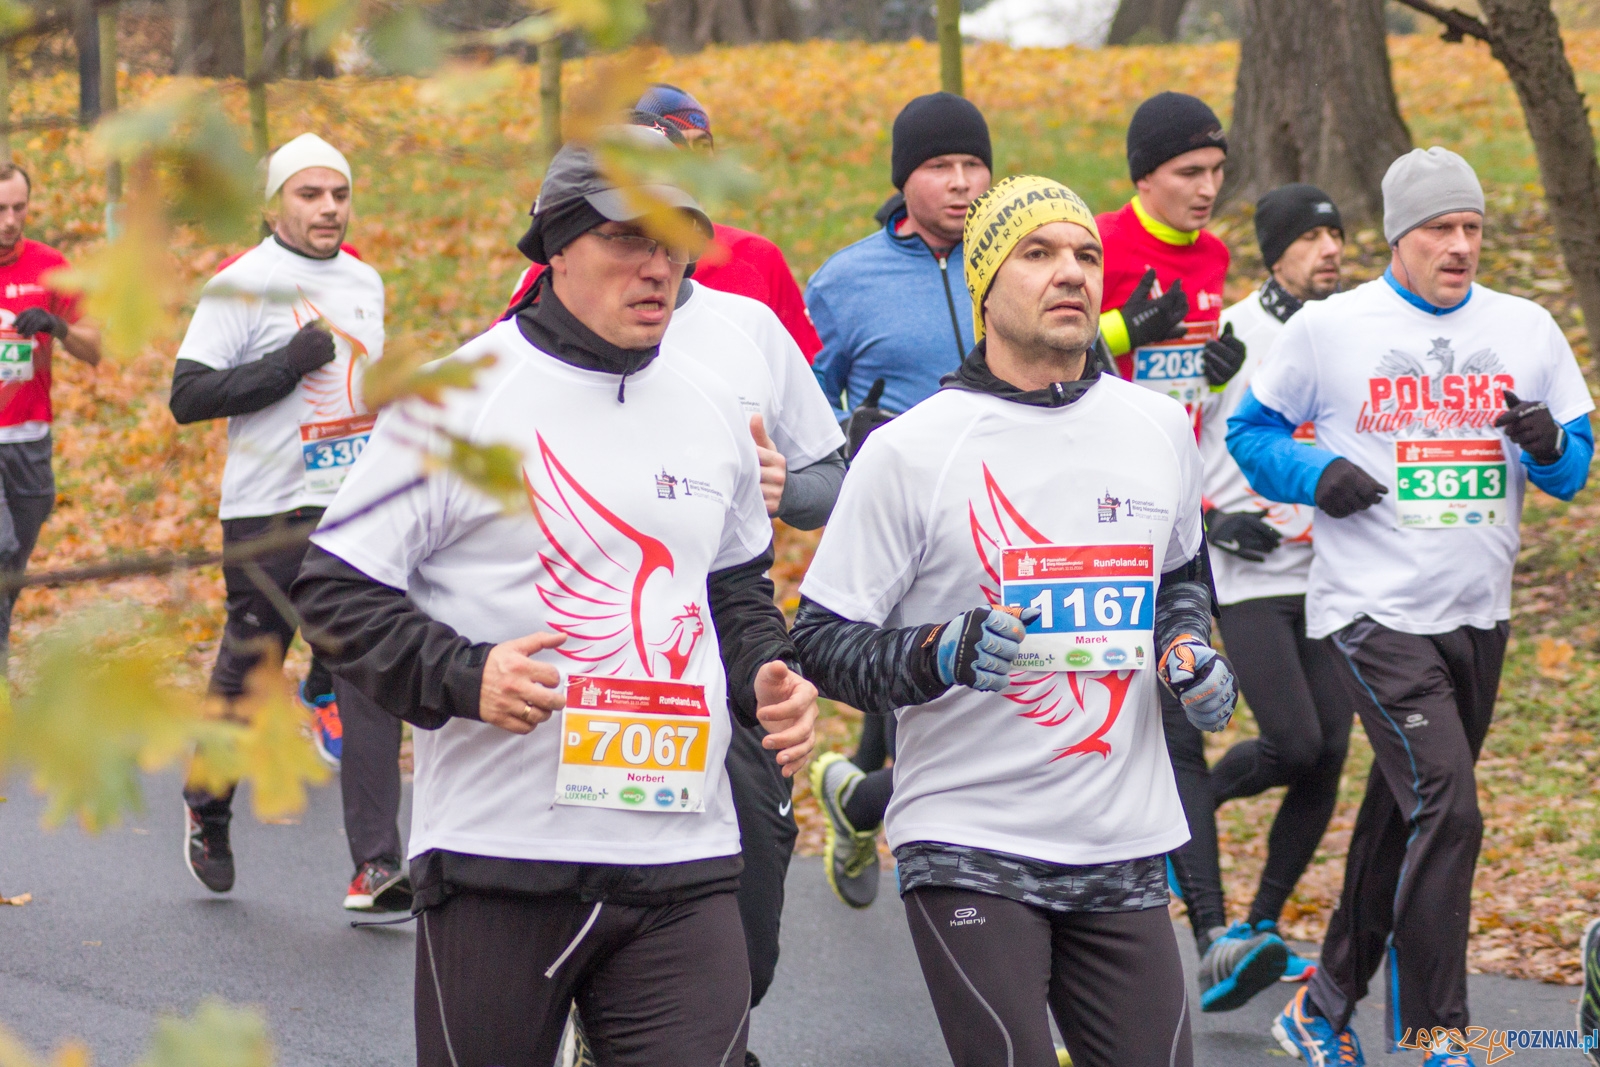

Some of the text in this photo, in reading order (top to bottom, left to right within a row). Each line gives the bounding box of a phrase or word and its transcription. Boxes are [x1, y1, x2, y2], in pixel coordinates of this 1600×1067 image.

[1368, 374, 1515, 414] POLSKA
[1412, 468, 1501, 498] 3613
[1093, 557, 1149, 570] RunPoland.org
[1030, 586, 1146, 629] 1167
[1075, 635, 1108, 644] Marek
[1014, 652, 1040, 660] RUPA
[658, 696, 702, 709] RunPoland.org
[567, 720, 698, 767] D 7067
[627, 773, 665, 783] Norbert
[565, 784, 593, 793] GRUPA
[564, 792, 598, 801] LUXMED
